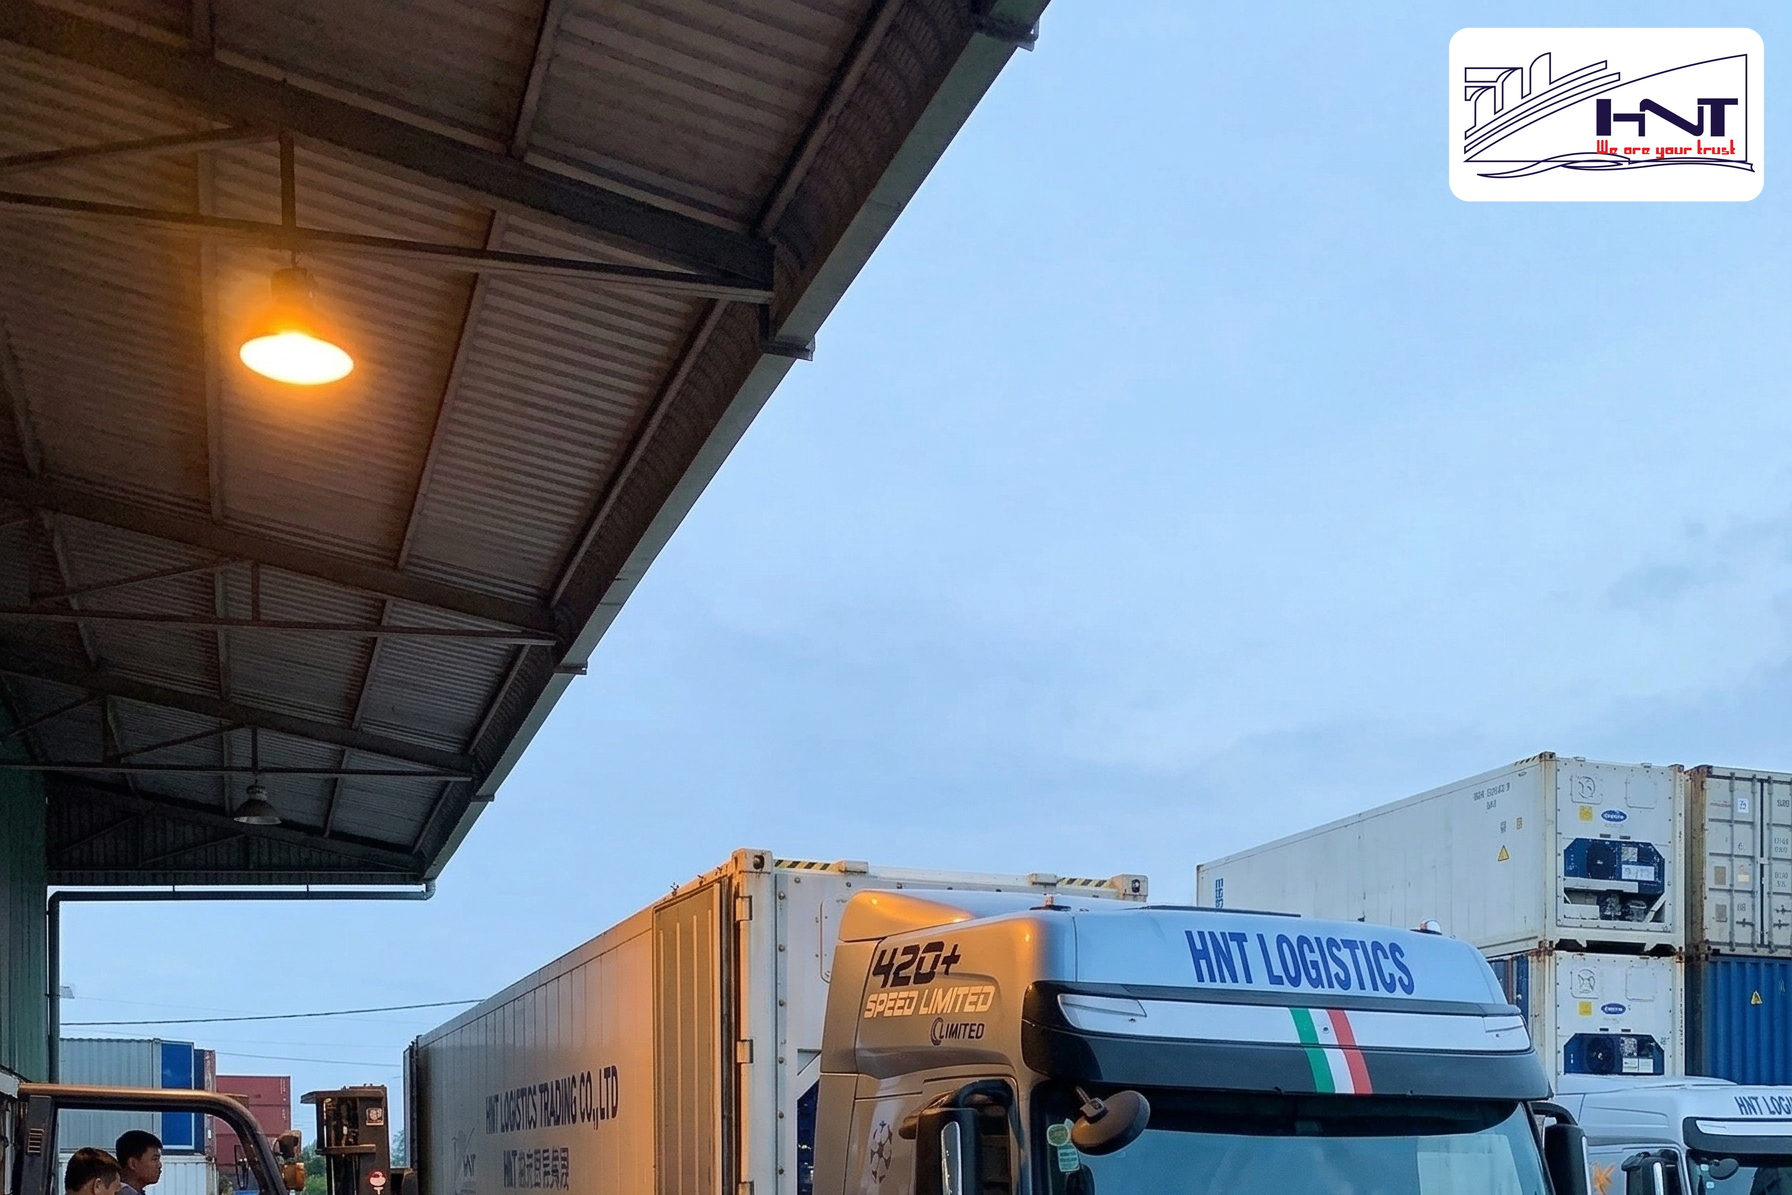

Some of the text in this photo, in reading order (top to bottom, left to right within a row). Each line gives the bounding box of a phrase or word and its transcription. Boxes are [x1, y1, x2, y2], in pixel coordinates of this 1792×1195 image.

[872, 941, 962, 989] 420+
[1184, 929, 1416, 997] HNT LOGISTICS
[863, 985, 996, 1019] SPEED LIMITED
[500, 1084, 538, 1134] LOGISTICS
[538, 1073, 577, 1128] TRADING
[1733, 1096, 1763, 1115] HNT
